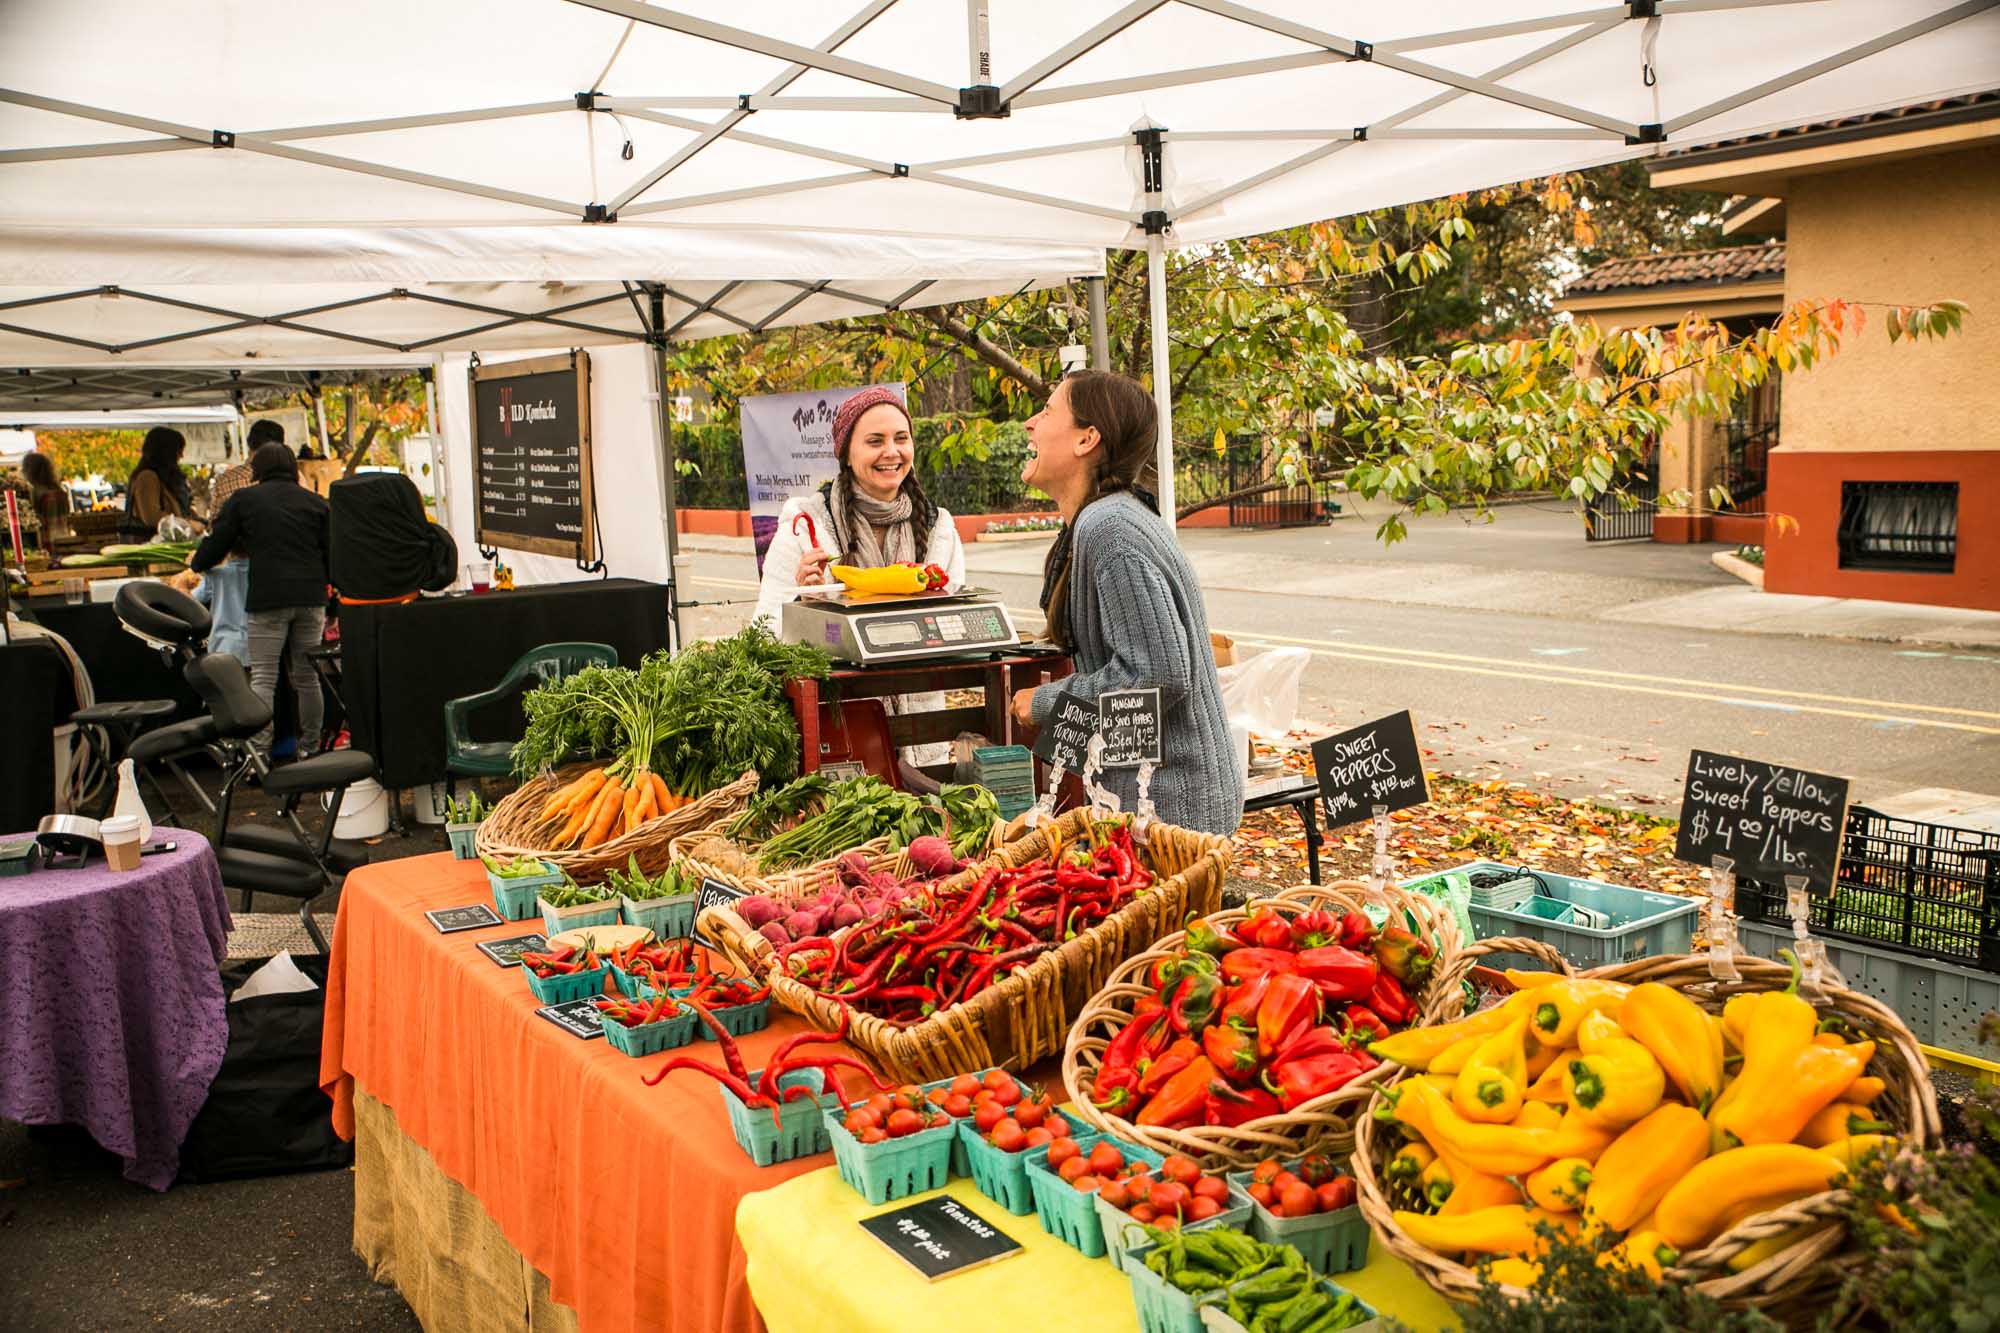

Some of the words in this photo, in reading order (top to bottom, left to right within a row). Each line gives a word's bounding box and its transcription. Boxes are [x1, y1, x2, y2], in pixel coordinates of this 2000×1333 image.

[1334, 730, 1377, 763] SWEET
[1329, 748, 1396, 788] PEPPERS
[1399, 775, 1416, 790] box
[1694, 755, 1759, 798] Lively
[1762, 765, 1839, 806] Yellow
[1690, 780, 1750, 811] Sweet
[1761, 793, 1834, 834] Peppers
[913, 1240, 952, 1261] pint
